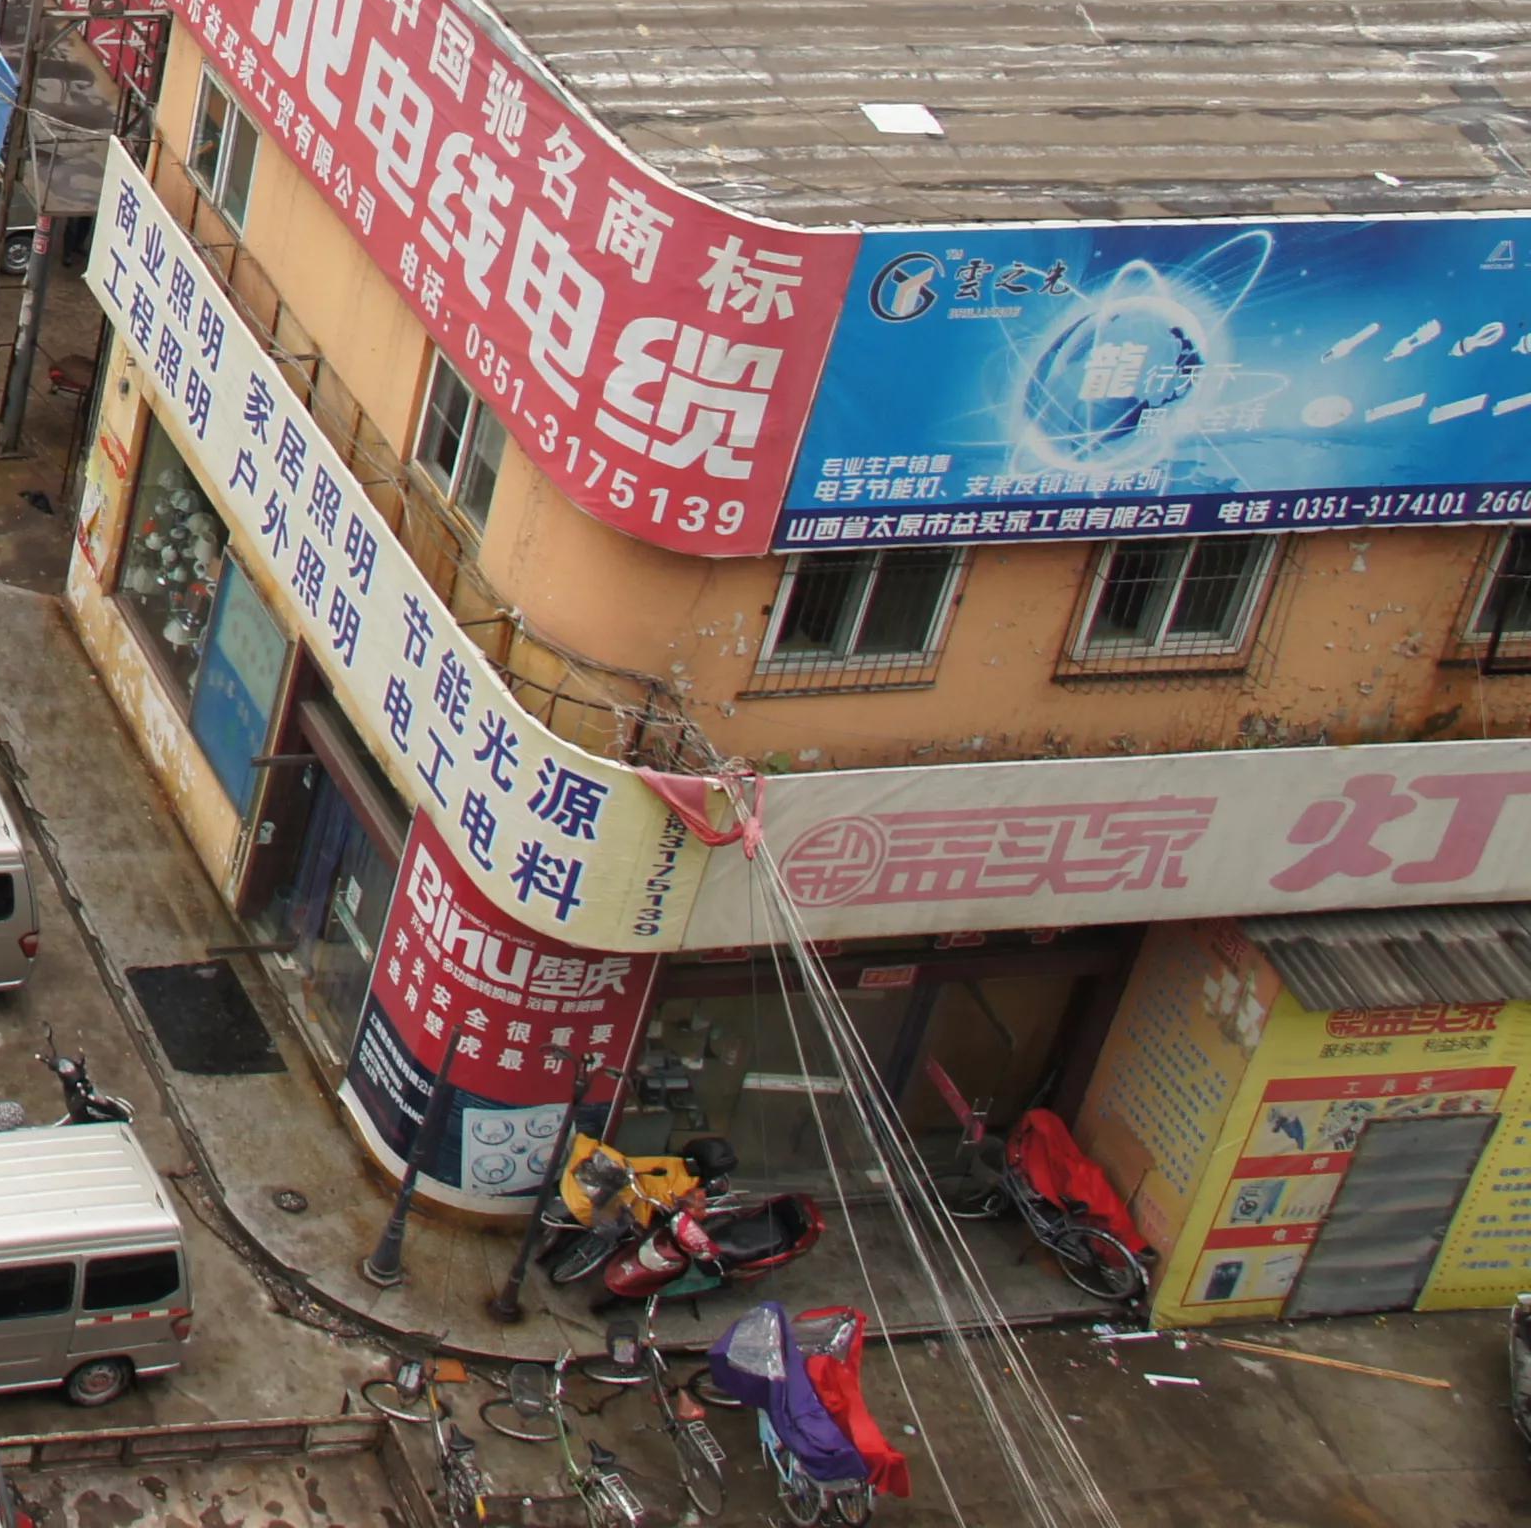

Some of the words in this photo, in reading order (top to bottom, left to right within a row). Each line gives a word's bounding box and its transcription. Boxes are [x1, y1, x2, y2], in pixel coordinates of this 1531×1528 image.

[954, 259, 1071, 301] 雲之光
[398, 240, 456, 344] 电话：
[464, 320, 747, 538] 0351-3175139
[115, 176, 226, 373] 商业照明
[247, 370, 379, 597] 家居照明
[402, 592, 610, 843] 节能光源
[785, 501, 1193, 545] 山西省太原市益买家工贸有限公司
[1217, 497, 1289, 524] 电话：
[1292, 491, 1467, 521] 0351-3174101
[820, 453, 953, 477] 专业生产销售
[101, 262, 212, 442] 工程照明
[227, 446, 363, 669] 户外照明
[381, 671, 587, 924] 电工电料
[1270, 772, 1531, 893] 灯
[406, 841, 535, 991] Bihu
[528, 953, 633, 999] 壁虎
[393, 926, 614, 1046] 开关安全很重要
